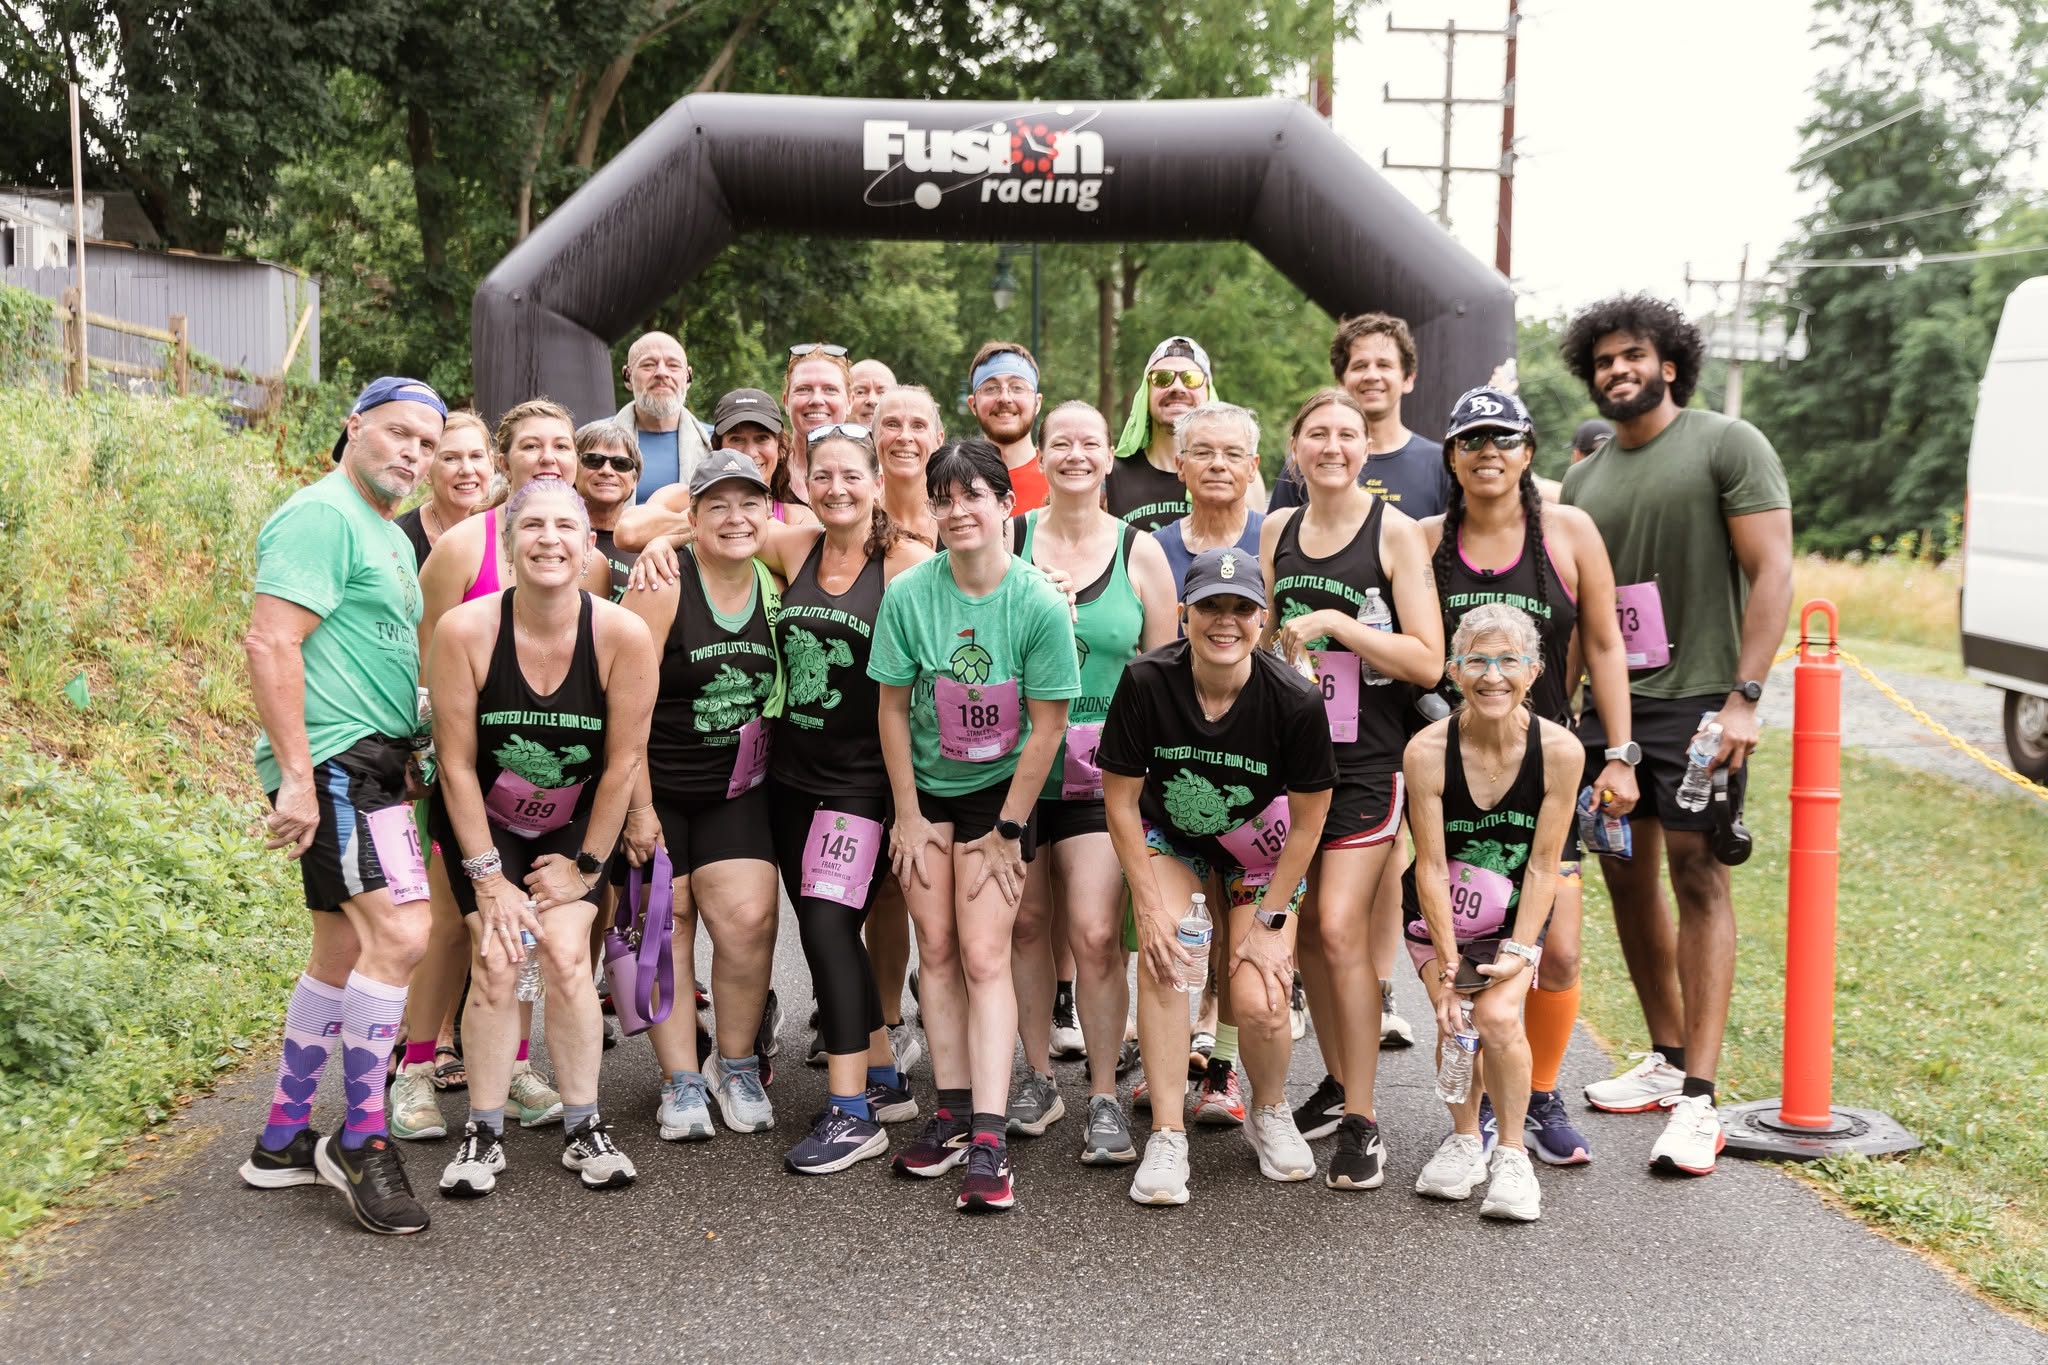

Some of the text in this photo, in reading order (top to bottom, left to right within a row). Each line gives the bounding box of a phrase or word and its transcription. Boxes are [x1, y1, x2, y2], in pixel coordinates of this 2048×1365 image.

[863, 118, 1104, 175] Fusion
[980, 178, 1102, 212] racing
[1123, 503, 1157, 523] TWISTED
[1157, 501, 1186, 513] LITTLE
[614, 560, 629, 575] RUN
[1294, 575, 1325, 589] LITTLE
[1325, 579, 1344, 596] RUN
[1344, 586, 1366, 606] CLUB
[1470, 593, 1504, 605] LITTLE
[1505, 593, 1526, 609] RUN
[802, 606, 831, 620] LITTLE
[830, 608, 848, 624] RUN
[848, 615, 871, 639] CLUB
[690, 641, 777, 664] TWISTED LITTLE RUN CL
[1322, 674, 1335, 701] 6
[1072, 695, 1110, 713] IRONS
[481, 711, 602, 731] TWISTED LITTLE RUN CLUB
[958, 704, 1000, 728] 188
[967, 728, 990, 737] STANLEY
[1153, 745, 1268, 776] TWISTED LITTLE RUN CLUB
[514, 799, 556, 818] 189
[1446, 810, 1536, 832] ISTED LITTLE RUN CL
[820, 832, 859, 864] 145
[1251, 819, 1287, 857] 159
[821, 861, 841, 872] FRANTZ
